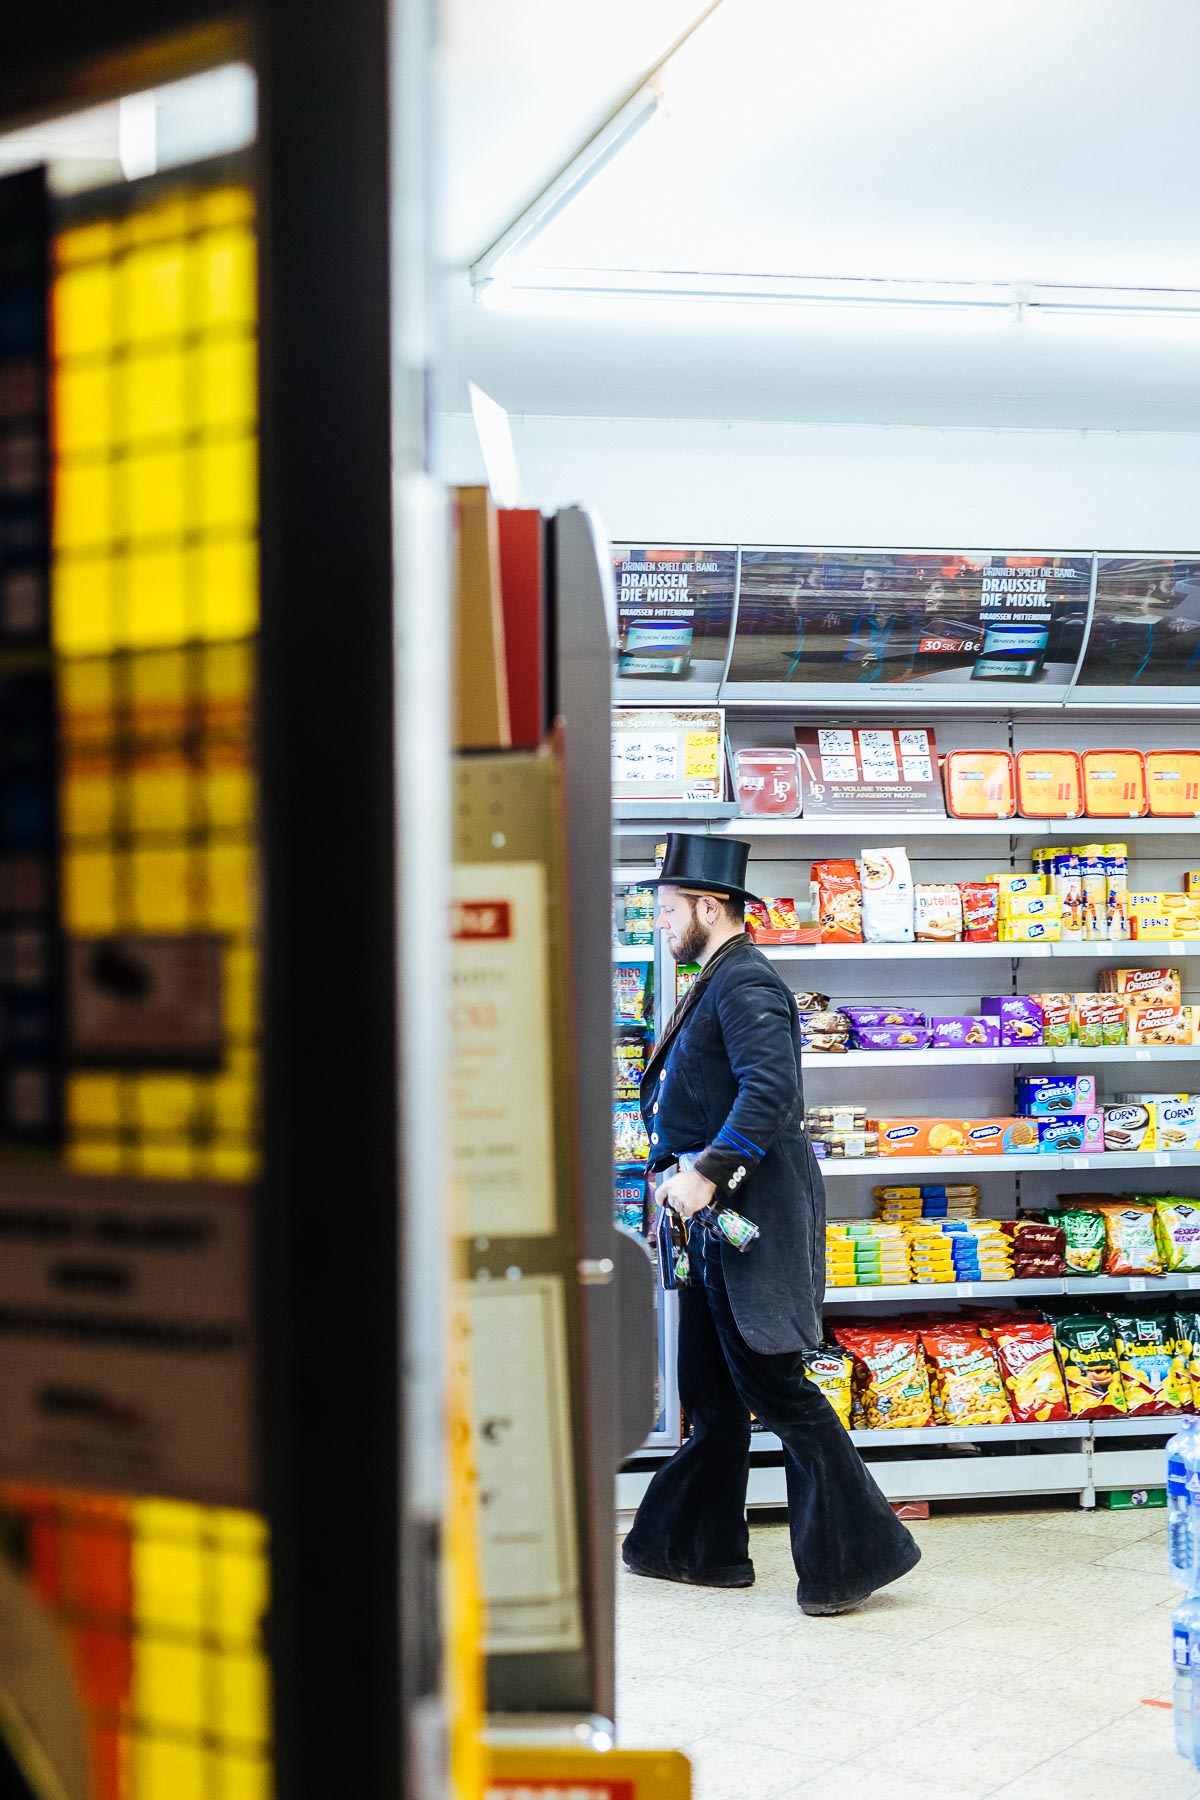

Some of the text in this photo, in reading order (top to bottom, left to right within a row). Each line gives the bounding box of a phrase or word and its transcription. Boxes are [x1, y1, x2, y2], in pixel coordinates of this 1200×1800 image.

[622, 561, 720, 572] DRINNEN SPIELT DIE BAND.
[983, 567, 1077, 578] DRINNEN SPIELT DIE BAND.
[621, 573, 688, 588] DRAUSSEN
[981, 579, 1047, 593] DRAUSSEN
[620, 588, 694, 602] DIE MUSIK.
[980, 593, 1052, 607] DIE MUSIK.
[619, 608, 653, 616] DRAUSSEN
[923, 641, 942, 651] 30
[686, 792, 710, 800] West
[919, 895, 959, 906] nutella
[1131, 895, 1157, 906] LEIBNIZ
[1141, 918, 1169, 928] LEIBNIZ
[1134, 970, 1160, 982] CHOCO
[1146, 1008, 1174, 1020] CHOCO
[1038, 1088, 1070, 1102] OREO
[1108, 1108, 1139, 1122] CORNY
[1164, 1107, 1196, 1121] CORNY
[1046, 1127, 1079, 1139] OREO
